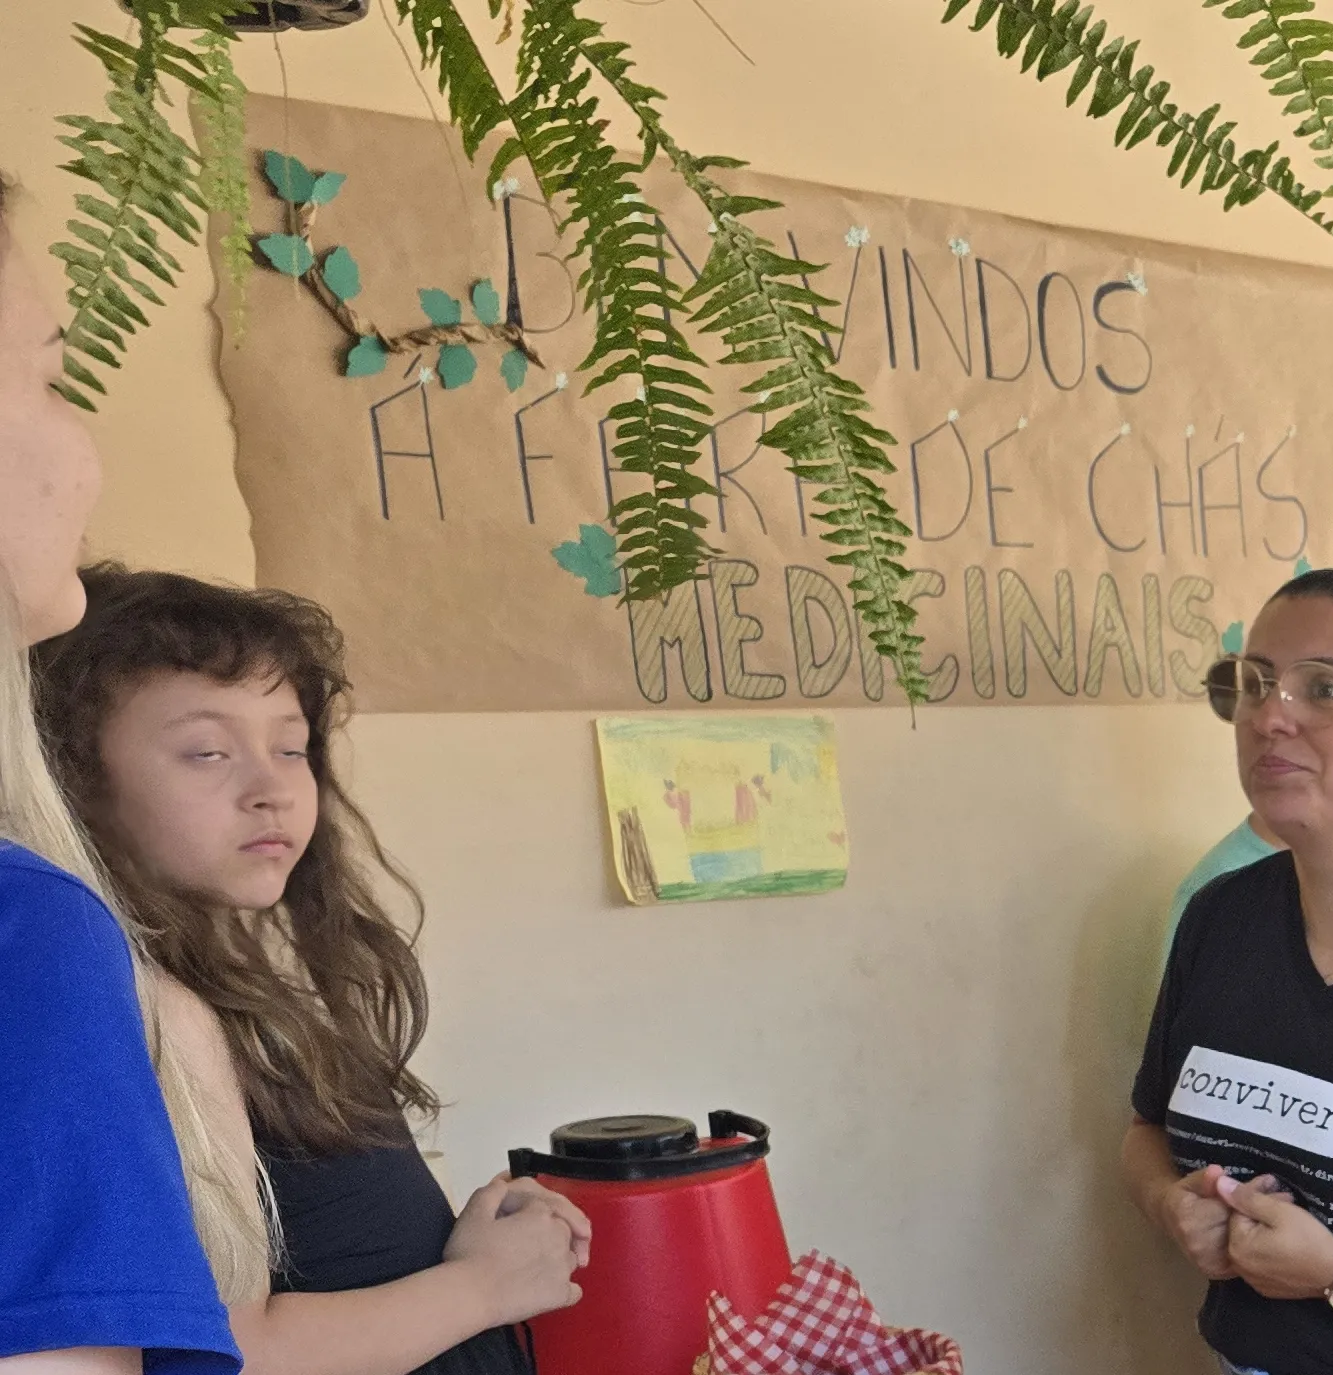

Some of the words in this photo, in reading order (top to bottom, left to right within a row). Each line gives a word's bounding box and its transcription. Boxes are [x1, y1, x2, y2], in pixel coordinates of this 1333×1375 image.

[787, 229, 1153, 394] VINDOS
[910, 420, 1034, 547] DE
[1088, 414, 1308, 561] CHÁS
